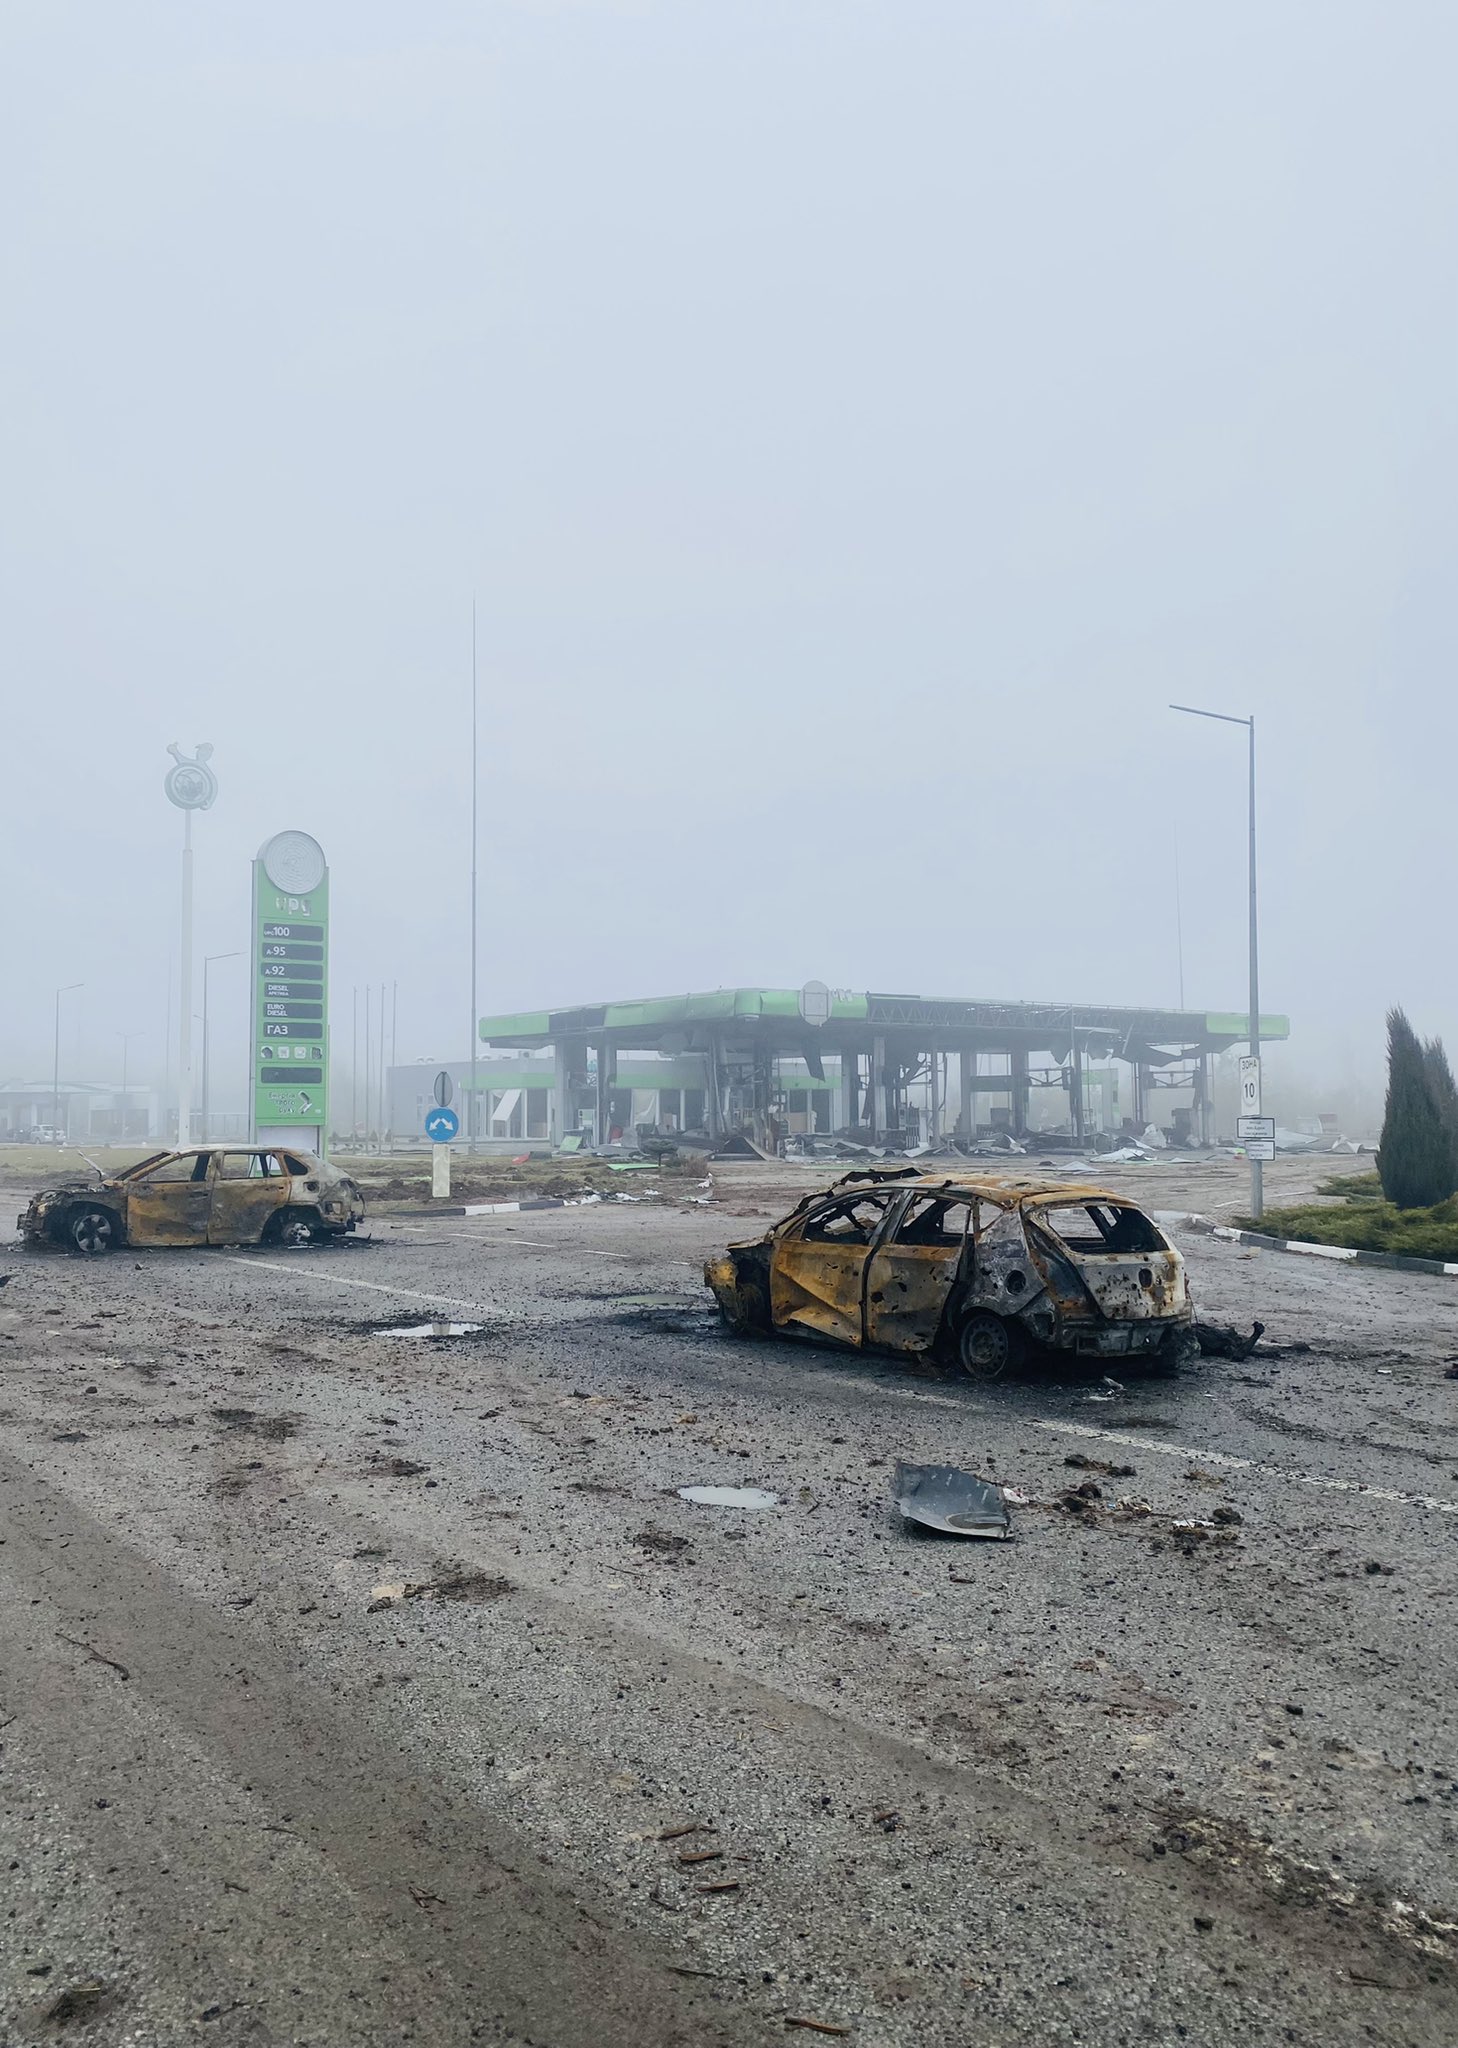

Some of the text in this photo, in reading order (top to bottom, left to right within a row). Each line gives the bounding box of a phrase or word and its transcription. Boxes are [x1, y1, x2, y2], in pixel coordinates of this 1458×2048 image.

[267, 1025, 289, 1035] ГАЗ
[1241, 1059, 1257, 1070] ЗОНА
[1244, 1082, 1255, 1098] 10
